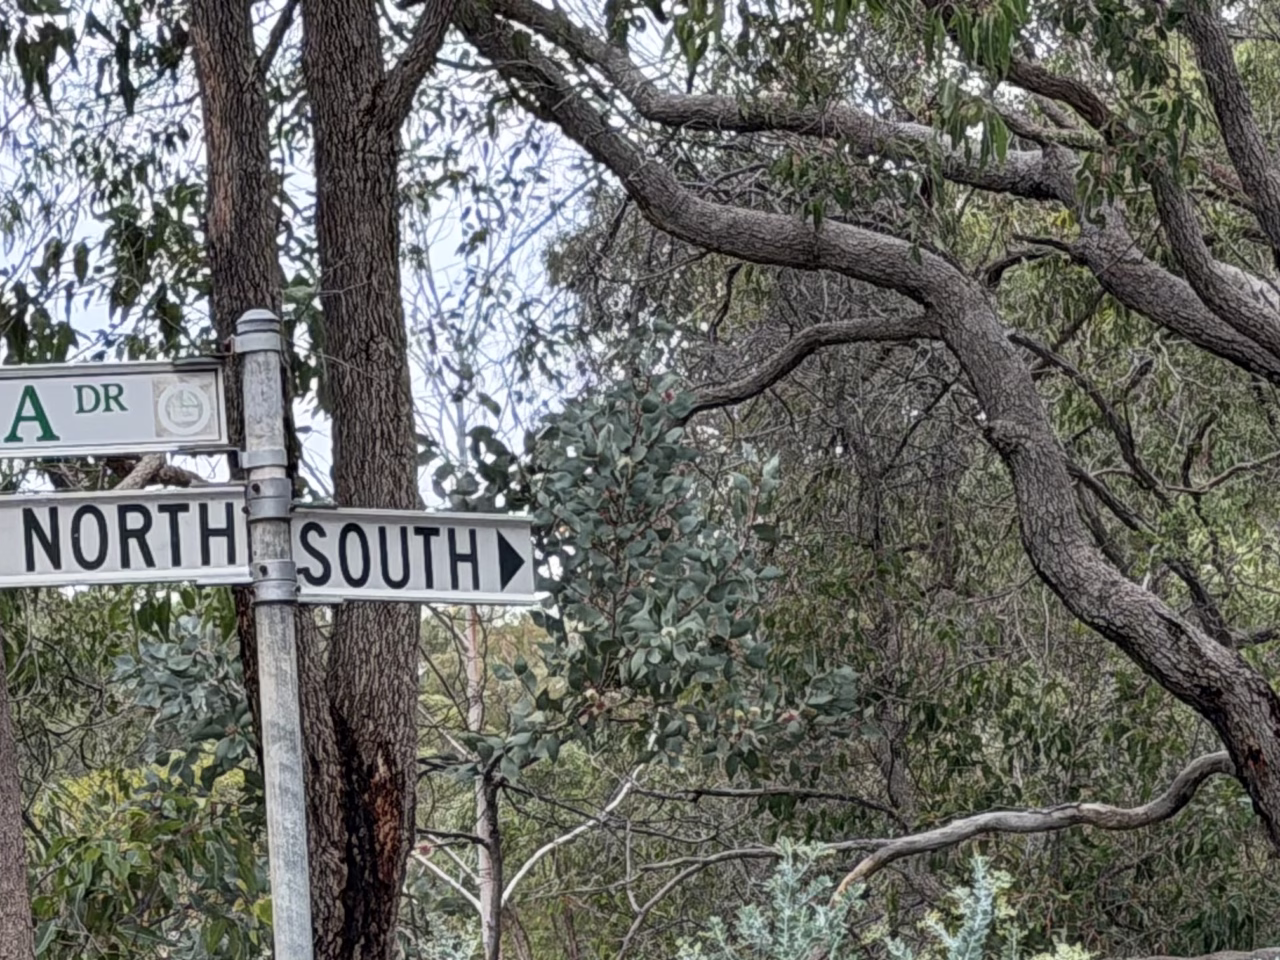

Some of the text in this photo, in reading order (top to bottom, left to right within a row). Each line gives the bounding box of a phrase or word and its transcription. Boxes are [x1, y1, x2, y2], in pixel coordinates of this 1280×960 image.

[74, 383, 128, 415] DR
[22, 502, 236, 572] NORTH
[297, 521, 480, 590] SOUTH
